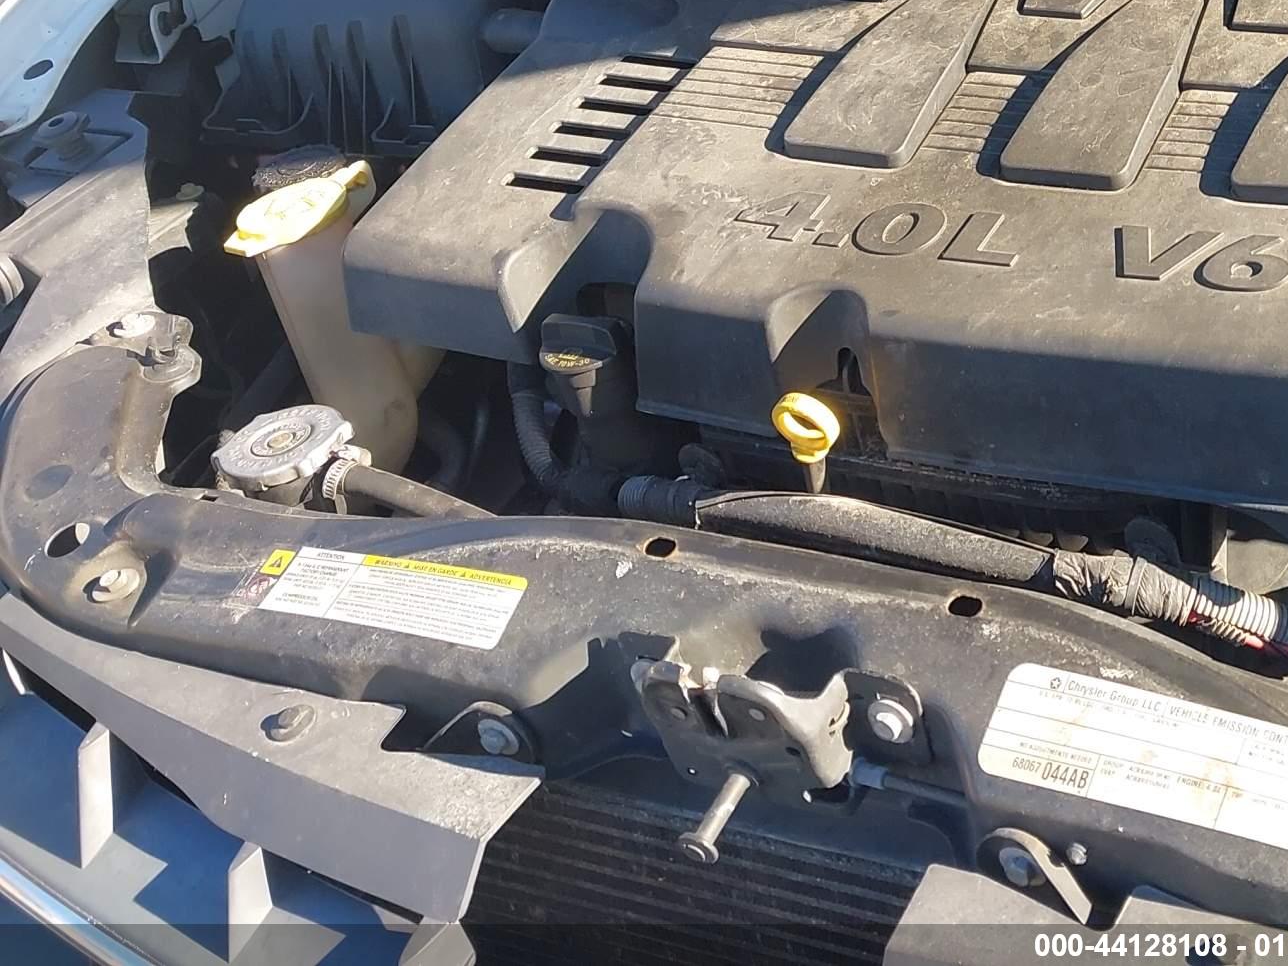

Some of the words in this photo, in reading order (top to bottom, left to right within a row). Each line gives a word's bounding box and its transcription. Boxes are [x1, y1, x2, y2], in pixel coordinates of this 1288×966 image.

[733, 190, 1020, 267] 4.0L
[1067, 679, 1107, 699] Chrysler
[1109, 690, 1140, 707] Group
[1142, 698, 1161, 712] LLC
[1169, 705, 1209, 724] VEHICLE
[1212, 717, 1260, 737] EMISSION
[1012, 756, 1042, 773] 68067
[1041, 761, 1090, 790] 044AB
